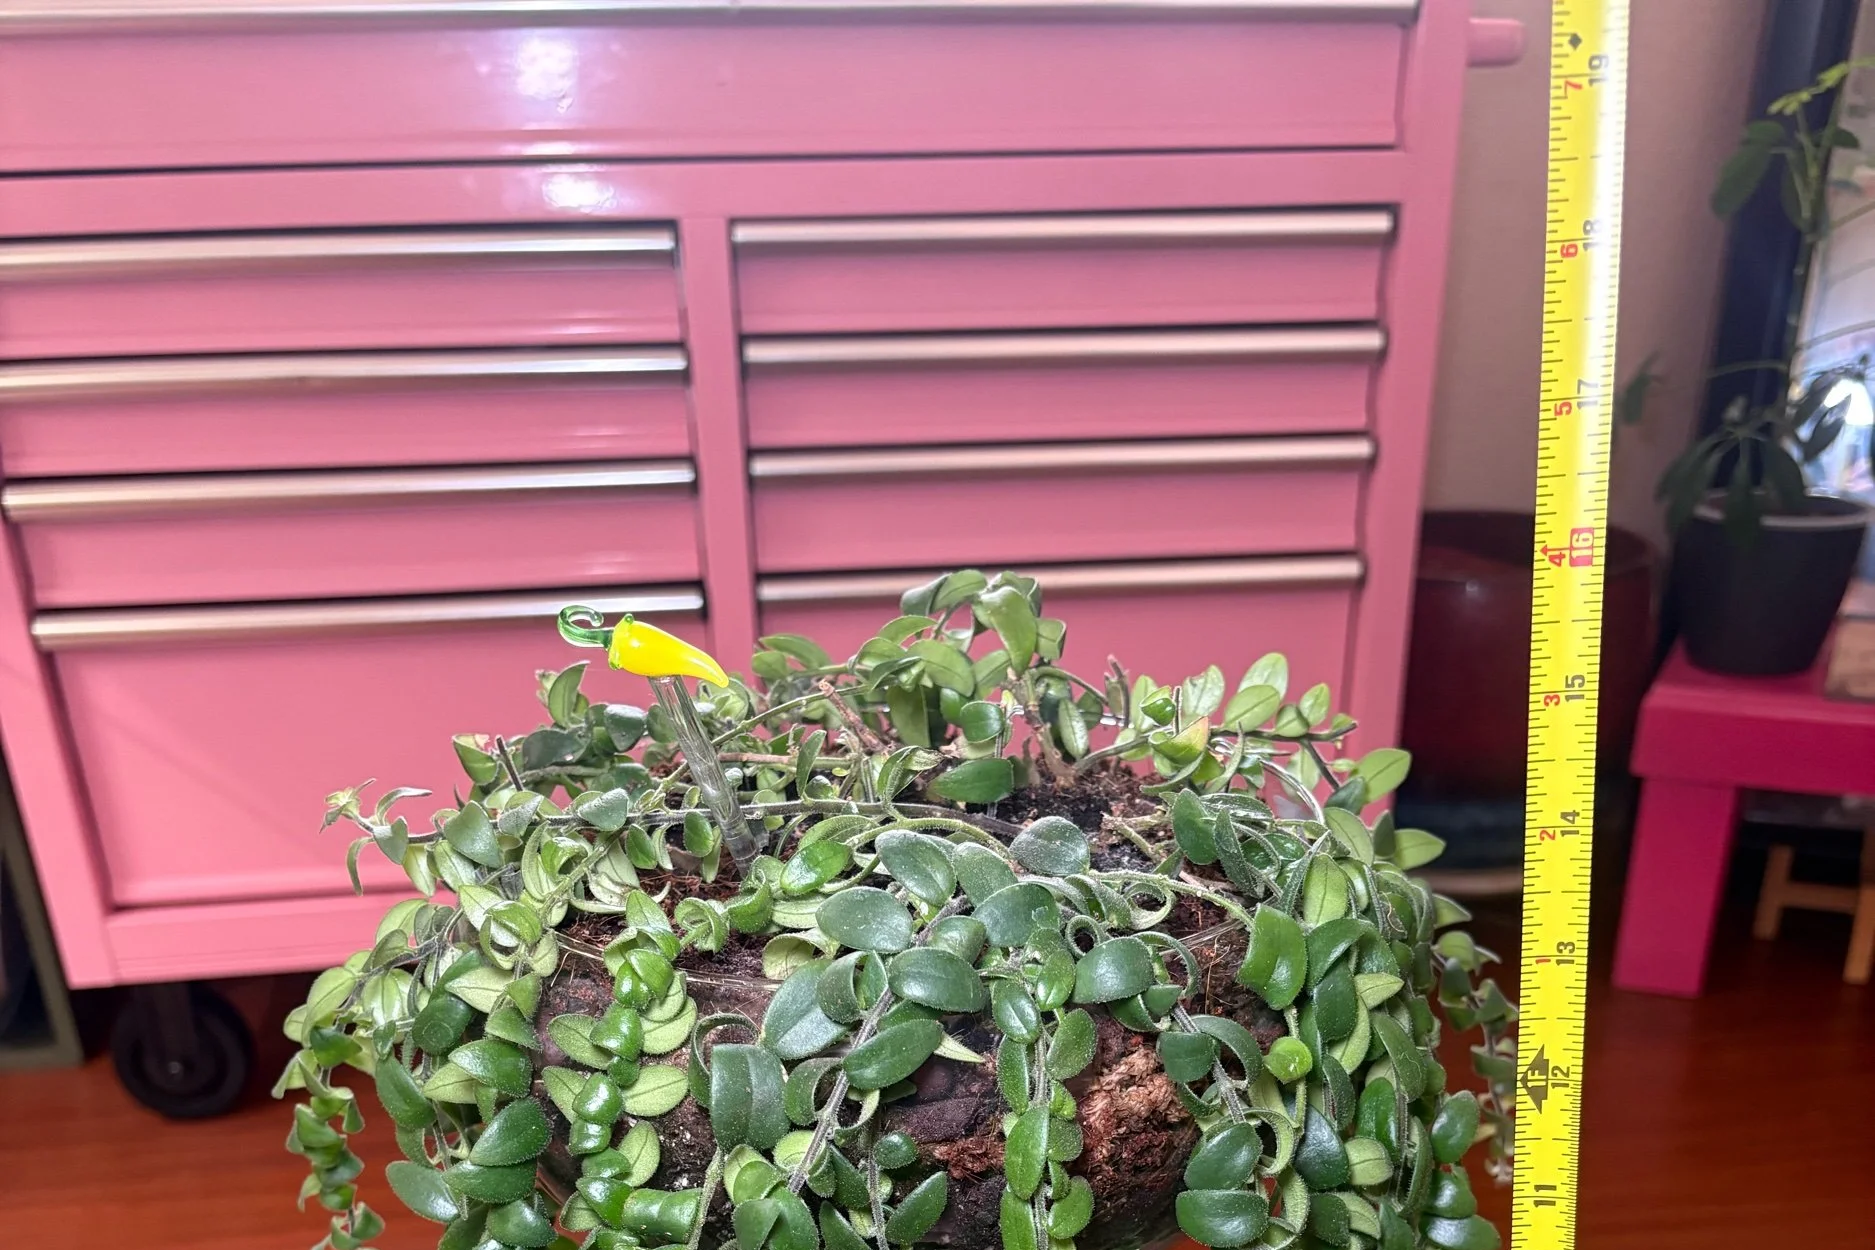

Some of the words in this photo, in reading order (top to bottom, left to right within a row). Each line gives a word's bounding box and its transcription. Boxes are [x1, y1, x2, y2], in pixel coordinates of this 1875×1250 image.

[1588, 55, 1609, 87] 19
[1564, 80, 1583, 99] 7
[1583, 220, 1602, 251] 18
[1560, 243, 1578, 258] 6
[1577, 379, 1599, 410] 17
[1554, 401, 1572, 416] 5
[1571, 532, 1593, 560] 16
[1548, 552, 1566, 567] 4
[1544, 694, 1560, 706] 3
[1565, 674, 1586, 702] 15
[1540, 829, 1556, 841] 2
[1560, 810, 1580, 837] 14
[1556, 941, 1575, 966] 13
[1551, 1065, 1570, 1089] 12
[1533, 1184, 1557, 1208] 11
